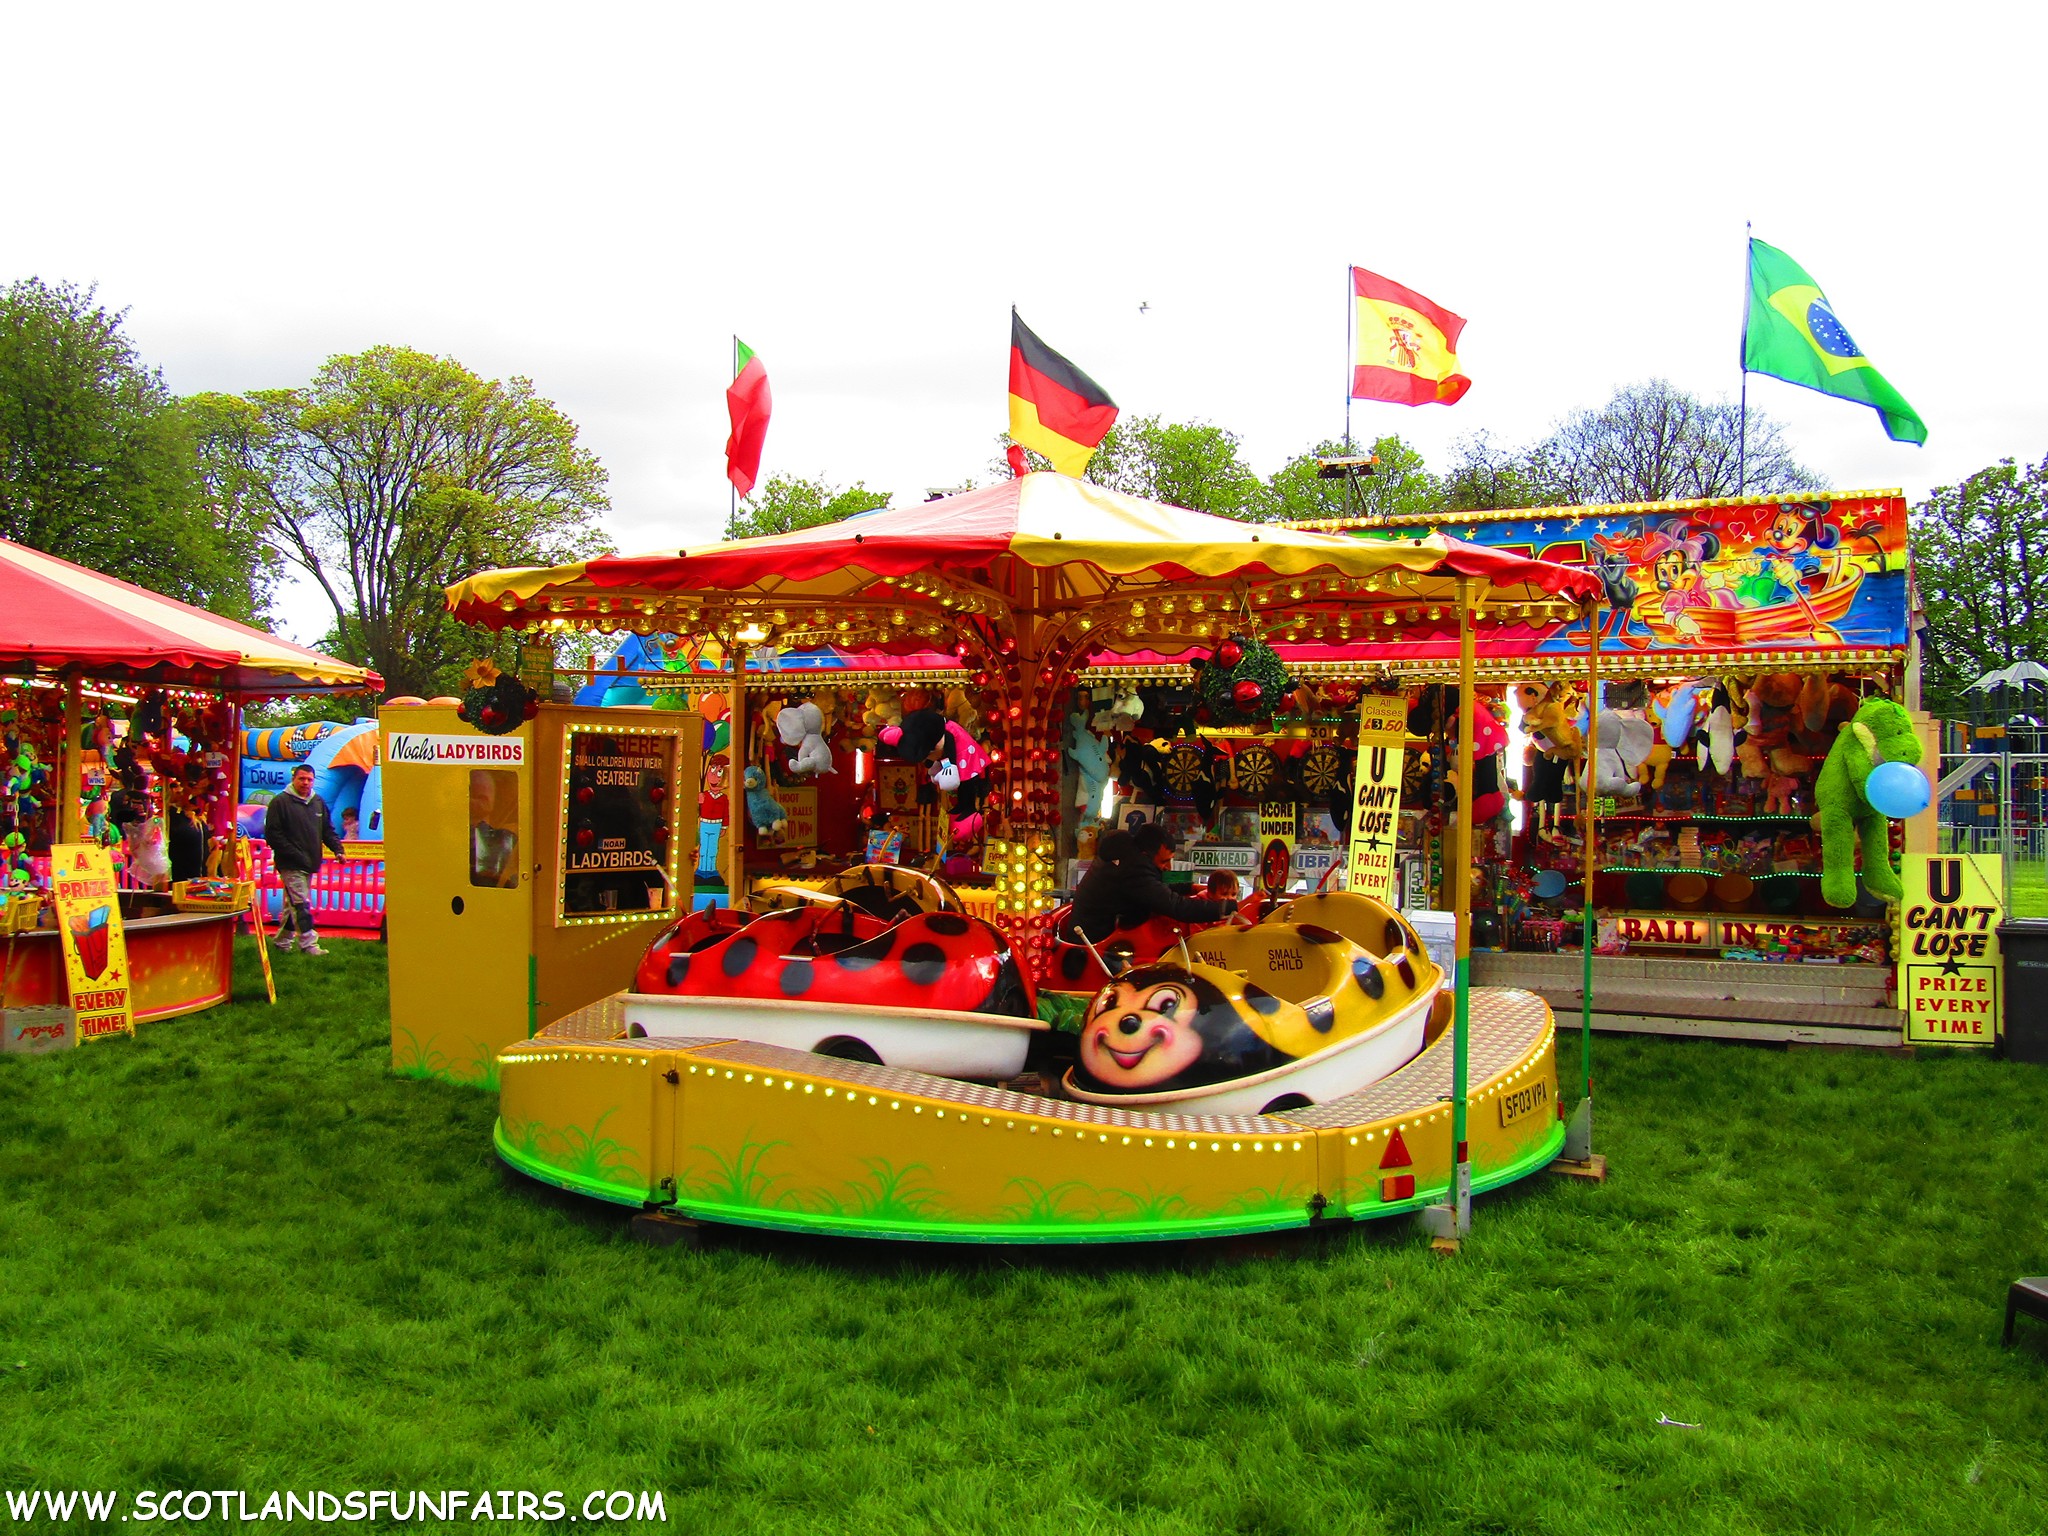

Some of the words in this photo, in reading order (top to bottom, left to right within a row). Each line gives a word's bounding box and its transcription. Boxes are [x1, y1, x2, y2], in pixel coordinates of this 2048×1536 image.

[1379, 698, 1391, 707] All
[1365, 706, 1403, 717] Classes
[1310, 727, 1327, 738] 30
[1363, 718, 1404, 732] £3.50
[391, 735, 436, 761] Noahs
[436, 743, 522, 760] LADYBIRDS
[574, 755, 595, 766] SMALL
[596, 756, 627, 767] CHILDREN
[627, 757, 643, 768] MUST
[644, 758, 663, 769] WEAR
[1371, 747, 1387, 782] U
[88, 777, 105, 785] WINS
[250, 769, 285, 785] DRIVE
[596, 770, 640, 786] SEATBELT
[778, 793, 800, 803] HOOT
[1359, 784, 1397, 808] CAN'T
[1260, 803, 1293, 818] SCORE
[1261, 821, 1294, 836] UNDER
[1359, 810, 1392, 834] LOSE
[603, 840, 625, 848] NOAH
[74, 852, 91, 871] A
[572, 850, 654, 868] LADYBIRDS
[1193, 852, 1249, 865] PARKHEAD
[1358, 853, 1388, 868] PRIZE
[1354, 873, 1387, 888] EVERY
[1928, 859, 1962, 904] U
[58, 879, 111, 900] PRIZE
[1907, 906, 1996, 930] CAN'T
[1623, 919, 1702, 944] BALL
[1722, 922, 1758, 946] IN
[1913, 933, 1989, 957] LOSE
[1200, 951, 1226, 961] MALL
[1268, 948, 1302, 960] SMALL
[1269, 959, 1303, 971] CHILD
[1919, 977, 1987, 992] PRIZE
[74, 988, 126, 1012] EVERY
[1915, 998, 1991, 1013] EVERY
[80, 1014, 126, 1037] TIME!
[1925, 1019, 1983, 1034] TIME
